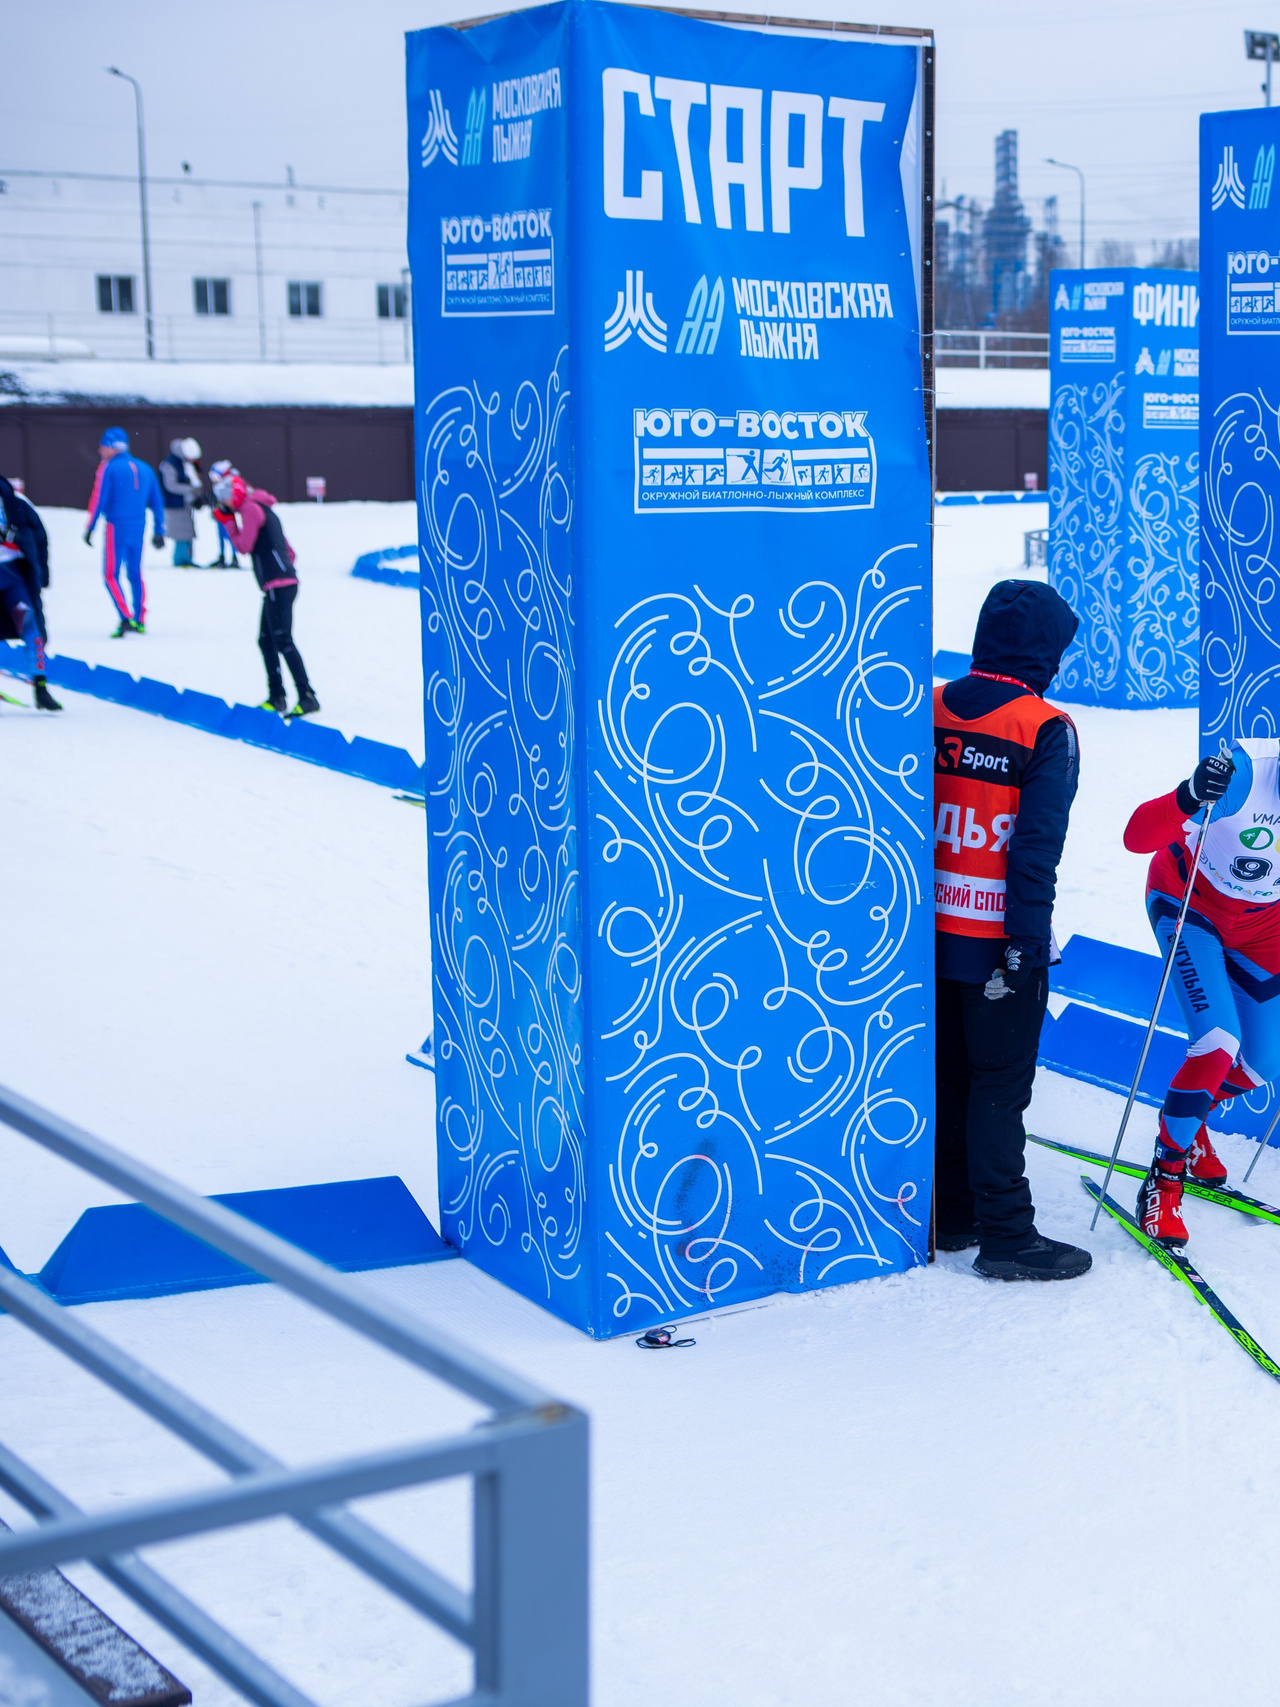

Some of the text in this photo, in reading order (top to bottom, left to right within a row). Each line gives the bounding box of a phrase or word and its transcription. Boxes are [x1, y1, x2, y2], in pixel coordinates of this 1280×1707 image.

[602, 67, 885, 238] СТАРТ
[441, 209, 552, 244] ЮГО-ВОСТОК
[732, 277, 893, 319] МОСКОВСКАЯ
[740, 322, 819, 360] ЛЫЖНЯ
[635, 409, 869, 440] ЮГО-ВОСТОК
[642, 488, 865, 501] ОКРУЖНОЙ БИАТЛОННО-ЛЫЖНЫЙ КОМПЛЕКС
[961, 746, 1009, 773] Sport
[934, 882, 971, 909] СКИЙ
[1149, 1241, 1174, 1269] FISCHER
